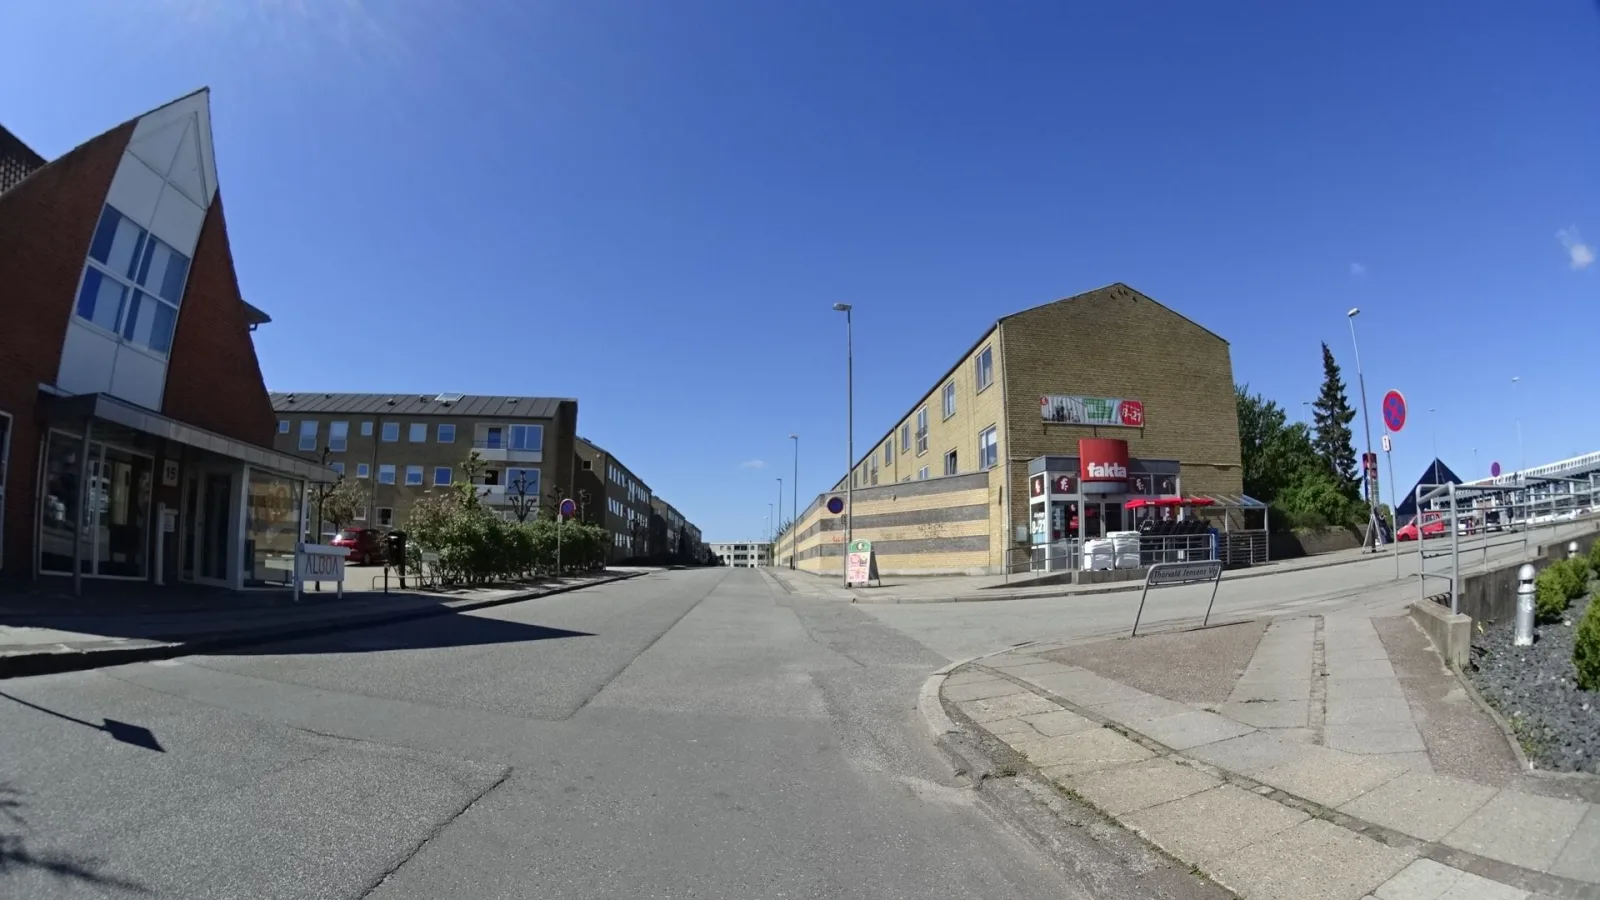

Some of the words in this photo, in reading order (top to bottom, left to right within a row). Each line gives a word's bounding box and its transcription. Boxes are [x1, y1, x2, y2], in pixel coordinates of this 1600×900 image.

[166, 465, 177, 480] 15
[1087, 462, 1127, 478] fakta
[1153, 568, 1181, 579] Thorvald
[1182, 568, 1207, 577] Jensens
